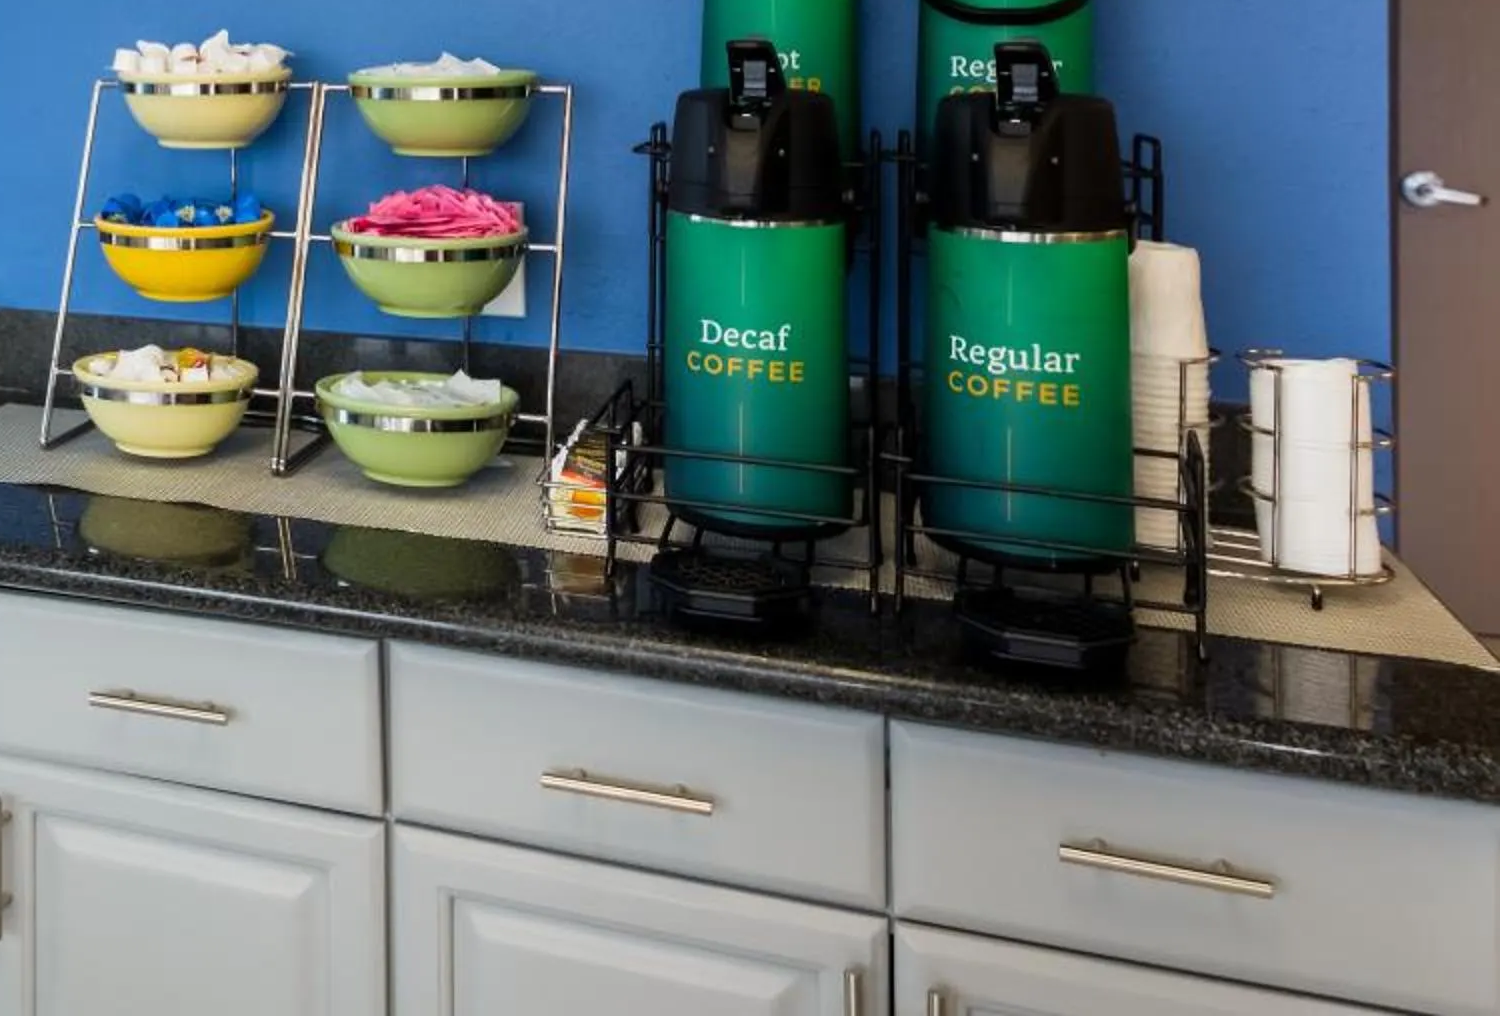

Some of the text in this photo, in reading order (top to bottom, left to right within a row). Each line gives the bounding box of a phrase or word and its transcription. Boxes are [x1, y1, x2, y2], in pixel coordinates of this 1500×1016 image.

[699, 319, 791, 351] Decaf
[687, 350, 804, 382] COFFEE
[949, 335, 1080, 375] Regular
[948, 370, 1080, 406] COFFEE
